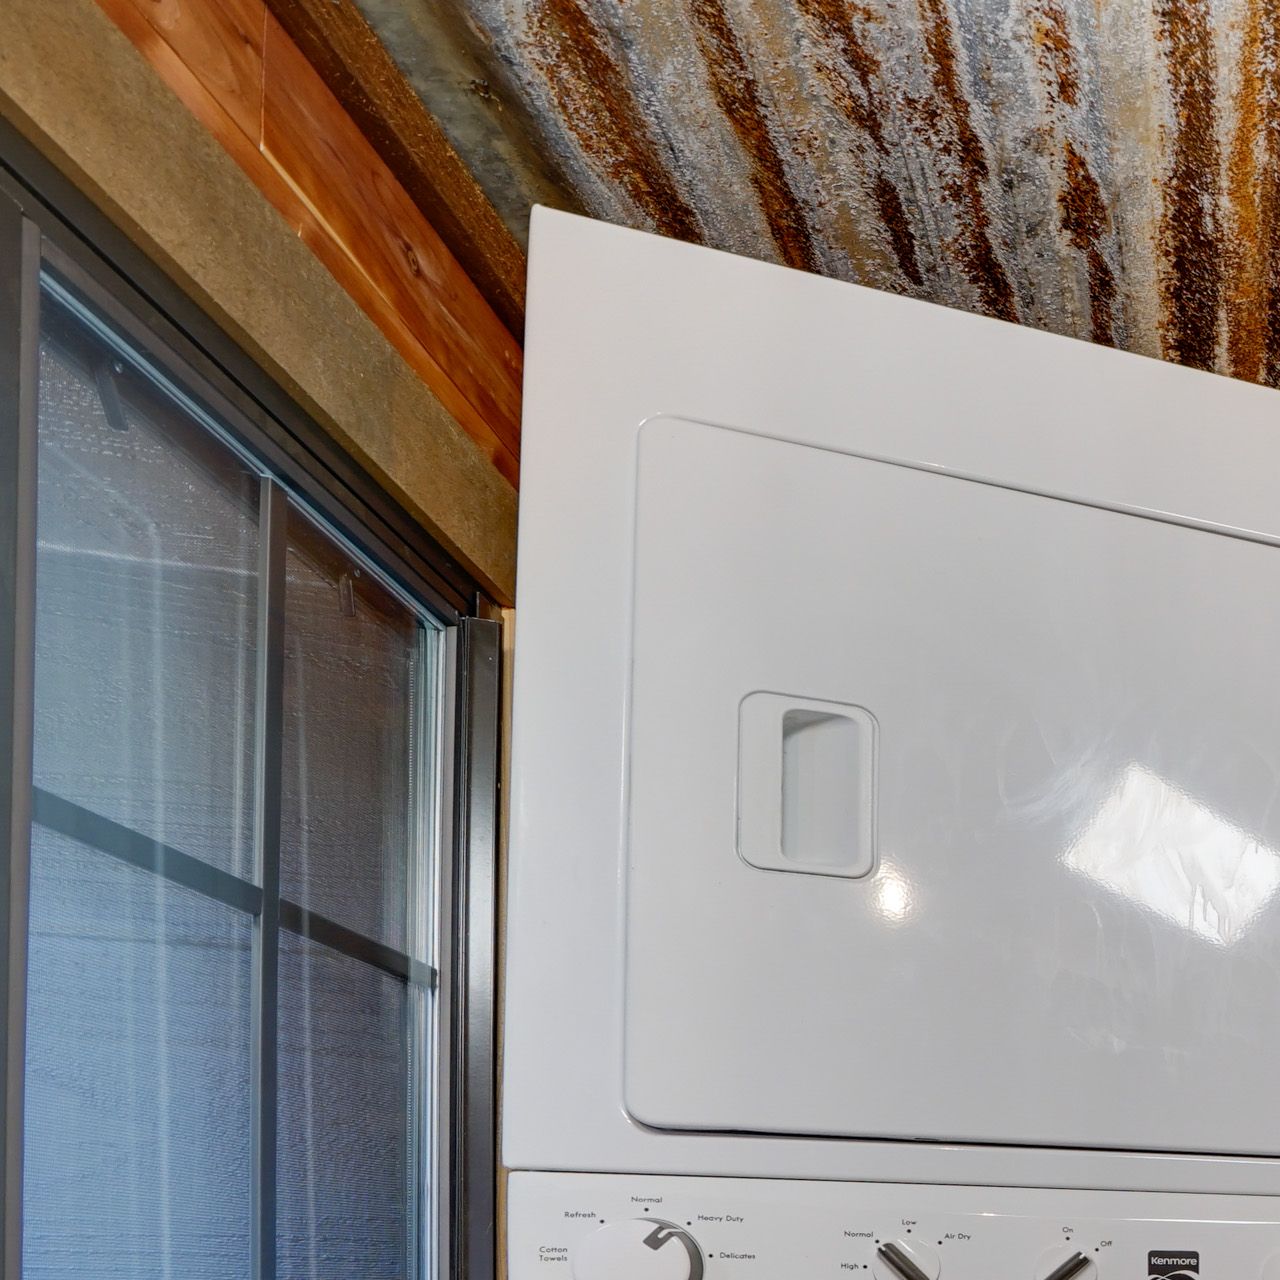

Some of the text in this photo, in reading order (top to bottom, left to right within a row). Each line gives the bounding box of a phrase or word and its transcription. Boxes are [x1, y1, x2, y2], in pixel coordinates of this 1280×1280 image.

[631, 1196, 663, 1204] Normal
[564, 1211, 596, 1219] Refresh
[958, 1233, 971, 1241] Dry
[539, 1246, 568, 1254] Cotton
[719, 1252, 756, 1260] Delicates
[1151, 1256, 1198, 1266] Kenmore
[841, 1262, 859, 1271] High
